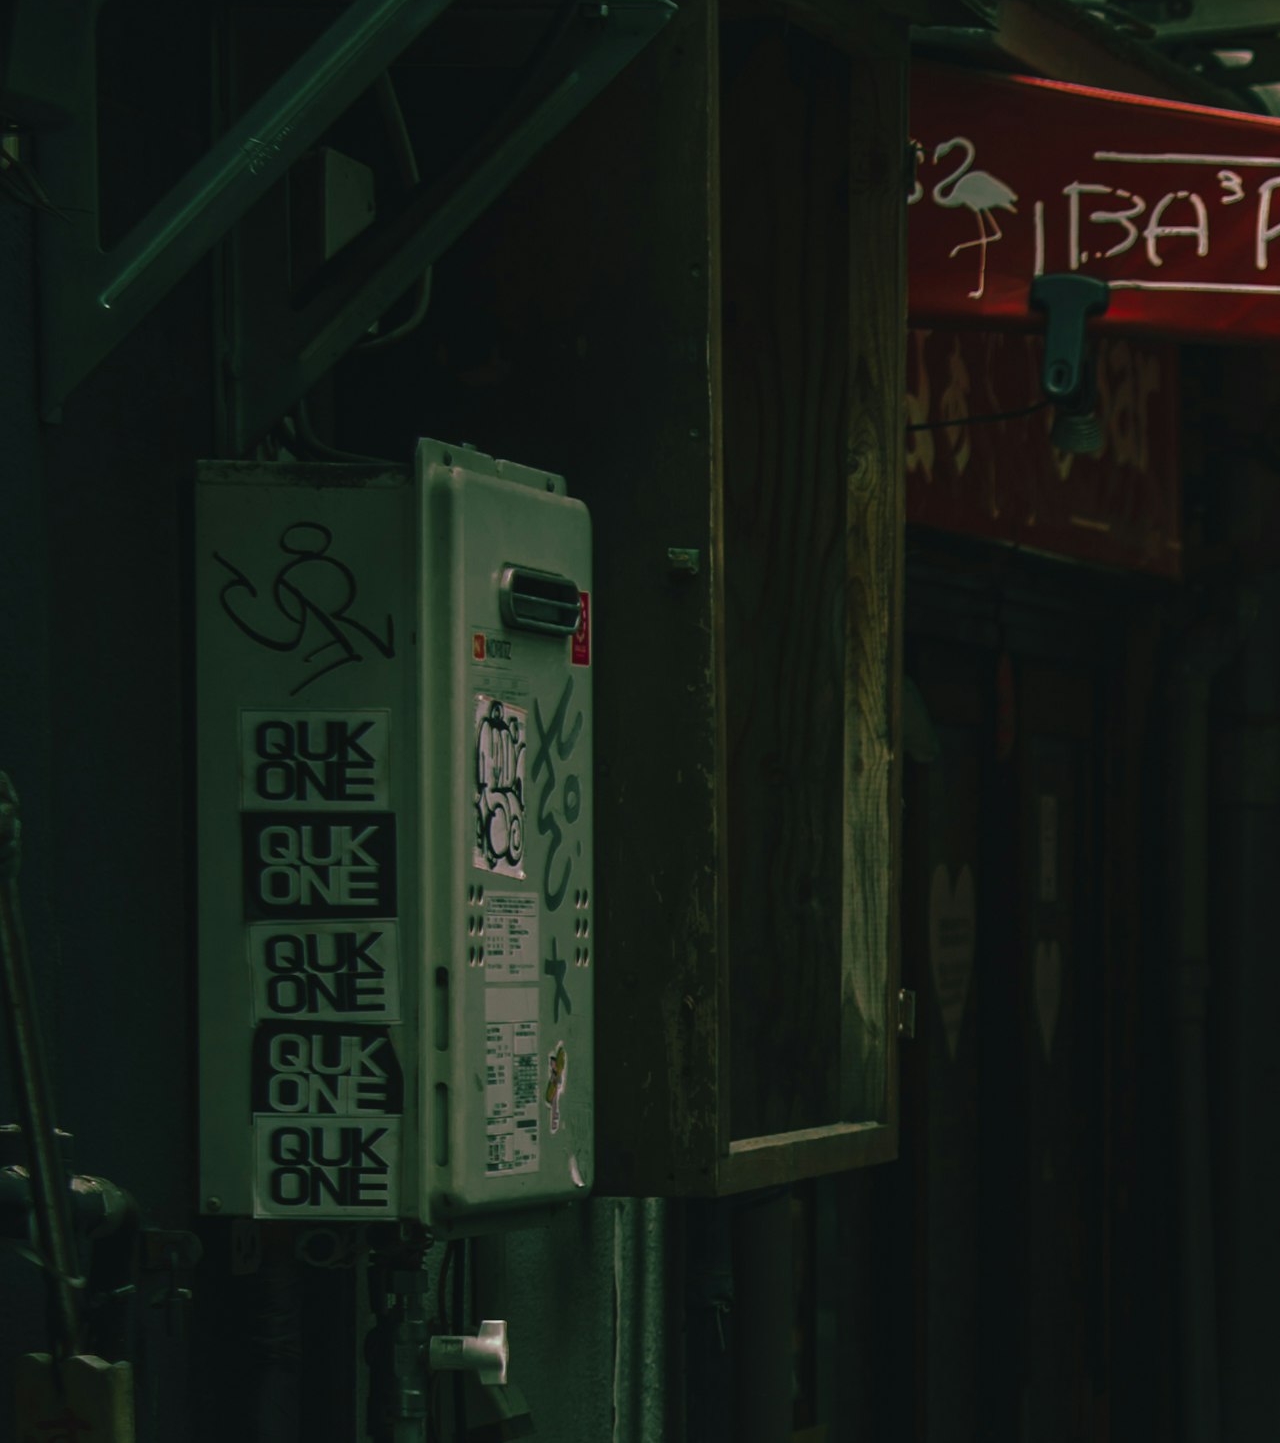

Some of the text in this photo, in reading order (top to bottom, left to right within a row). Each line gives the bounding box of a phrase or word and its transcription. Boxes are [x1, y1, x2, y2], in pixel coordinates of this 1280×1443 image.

[256, 720, 376, 762] QUK
[256, 761, 375, 802] ONE
[259, 825, 381, 867] QUK
[260, 865, 380, 906] ONE
[265, 931, 386, 974] QUK
[267, 971, 386, 1015] ONE
[269, 1032, 389, 1078] QUK
[268, 1072, 388, 1115] ONE
[271, 1126, 390, 1169] QUK
[271, 1166, 389, 1207] ONE
